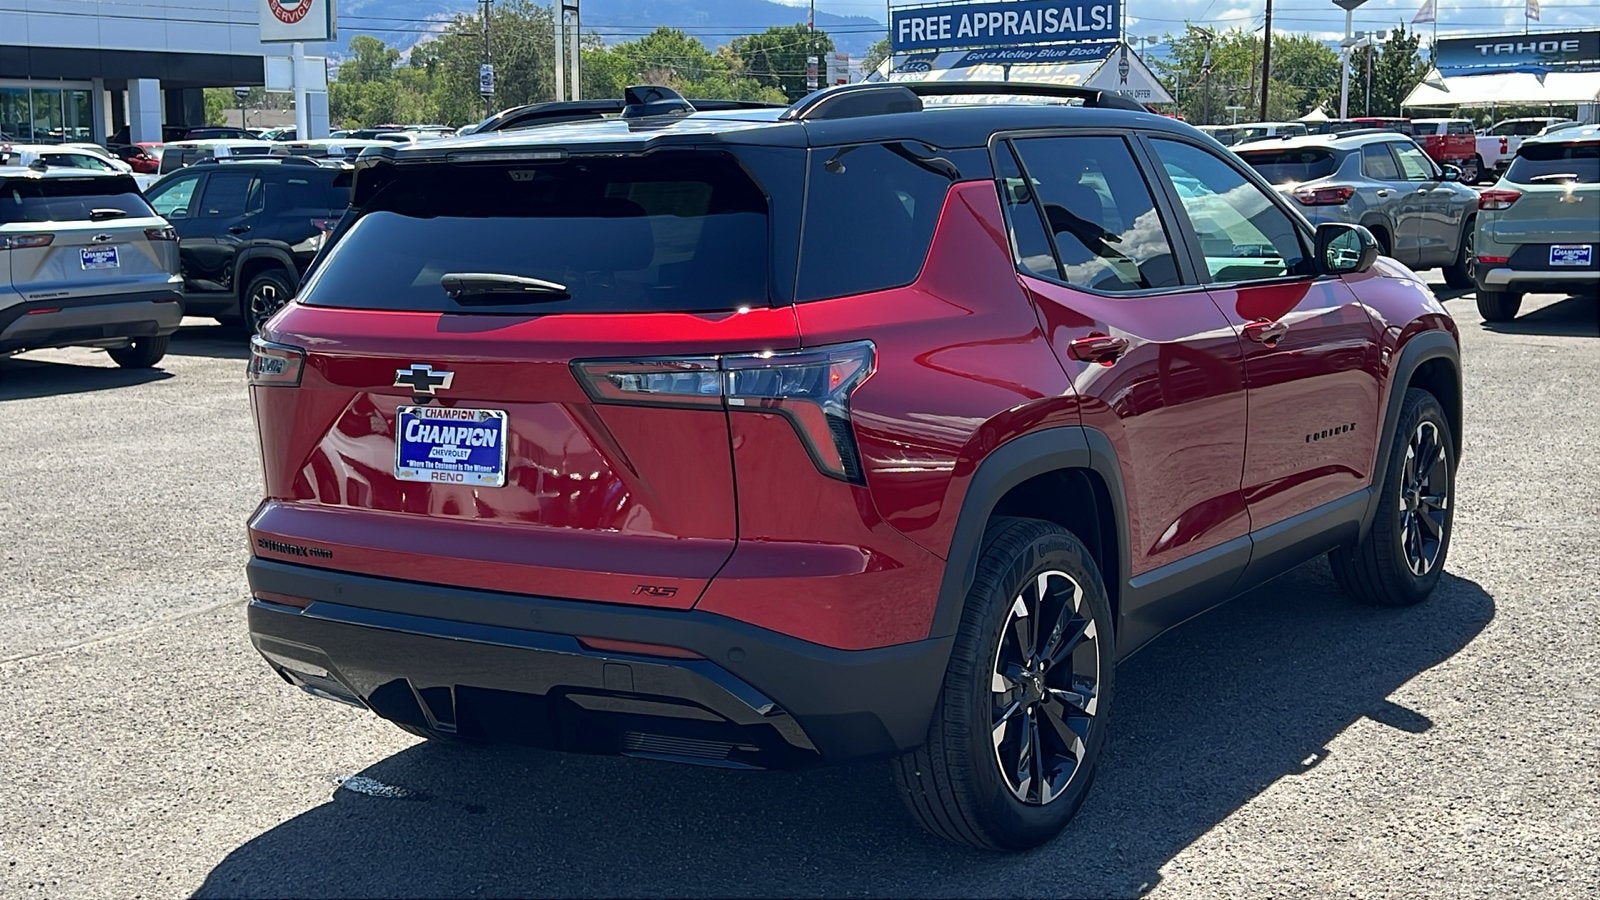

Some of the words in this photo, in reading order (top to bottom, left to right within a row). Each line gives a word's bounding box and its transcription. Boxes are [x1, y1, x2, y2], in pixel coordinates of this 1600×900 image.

[270, 0, 311, 22] SERVICE
[898, 15, 951, 43] FREE
[957, 5, 1113, 38] APPRAISALS!
[967, 52, 987, 60] Get
[997, 50, 1036, 60] Kelley
[1037, 48, 1064, 58] Blue
[1068, 46, 1102, 56] Book
[1475, 40, 1580, 56] TAHOE
[425, 408, 475, 420] CHAMPION
[405, 419, 498, 447] CHAMPION
[432, 447, 468, 458] CHEVROLET
[425, 460, 434, 469] The
[464, 463, 473, 471] The
[431, 472, 464, 482] RENO
[257, 539, 309, 557] EQUINOX
[631, 584, 679, 597] RS
